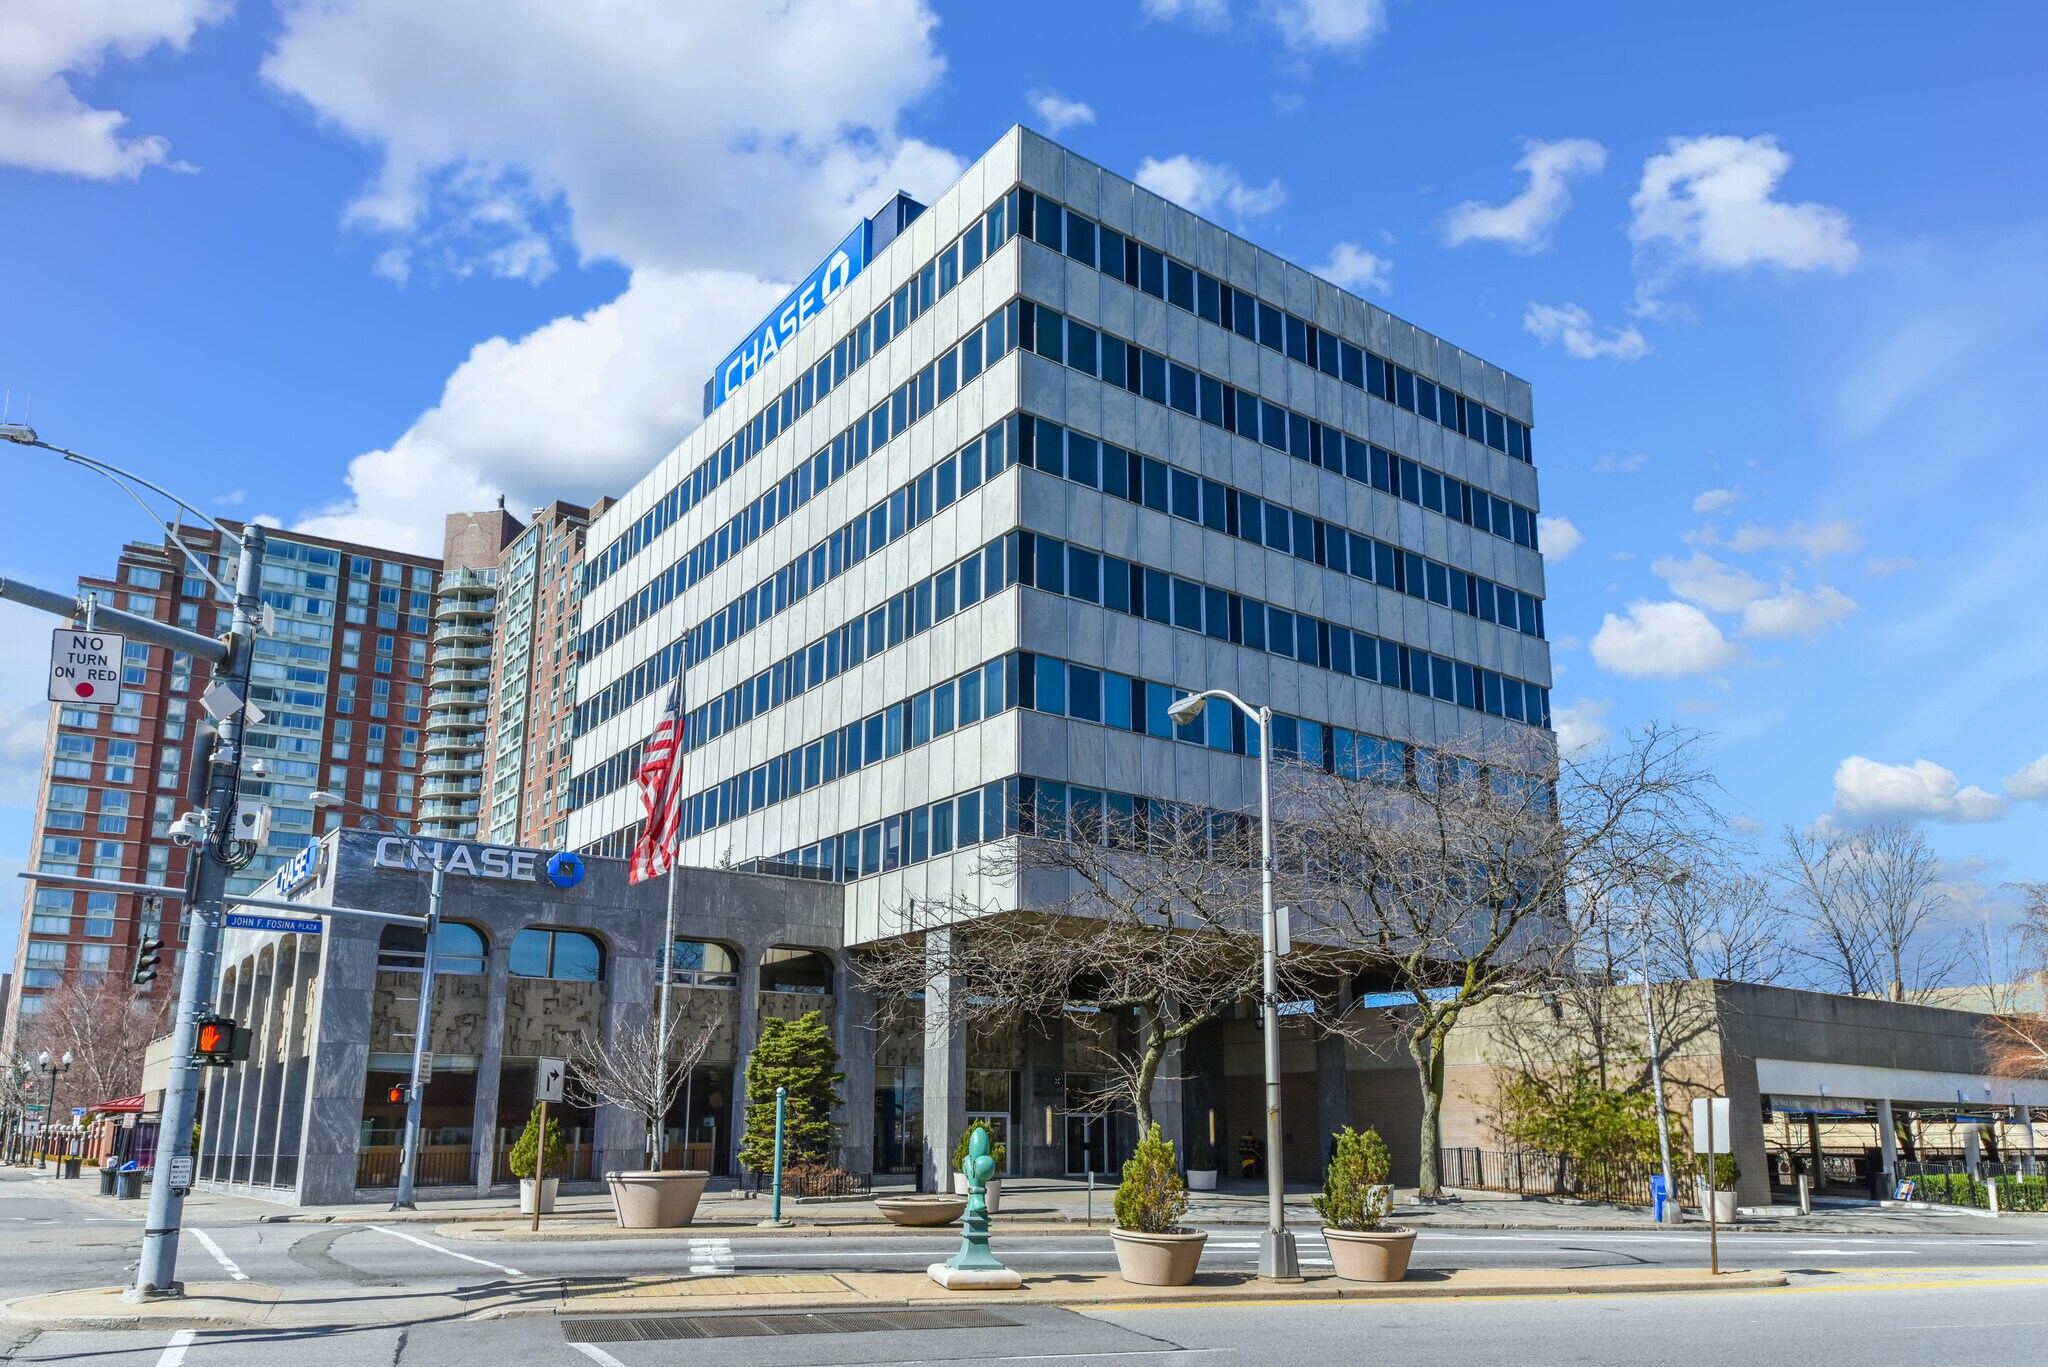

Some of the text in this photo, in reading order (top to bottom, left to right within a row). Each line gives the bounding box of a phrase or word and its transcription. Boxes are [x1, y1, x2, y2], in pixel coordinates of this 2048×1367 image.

[724, 280, 820, 400] CHASE
[73, 636, 103, 651] NO
[67, 652, 108, 666] TURN
[55, 666, 117, 681] ON RED
[376, 837, 539, 882] CHASE
[274, 848, 309, 896] CHASE
[231, 917, 317, 931] JOHN F. FOSINA PLAZA
